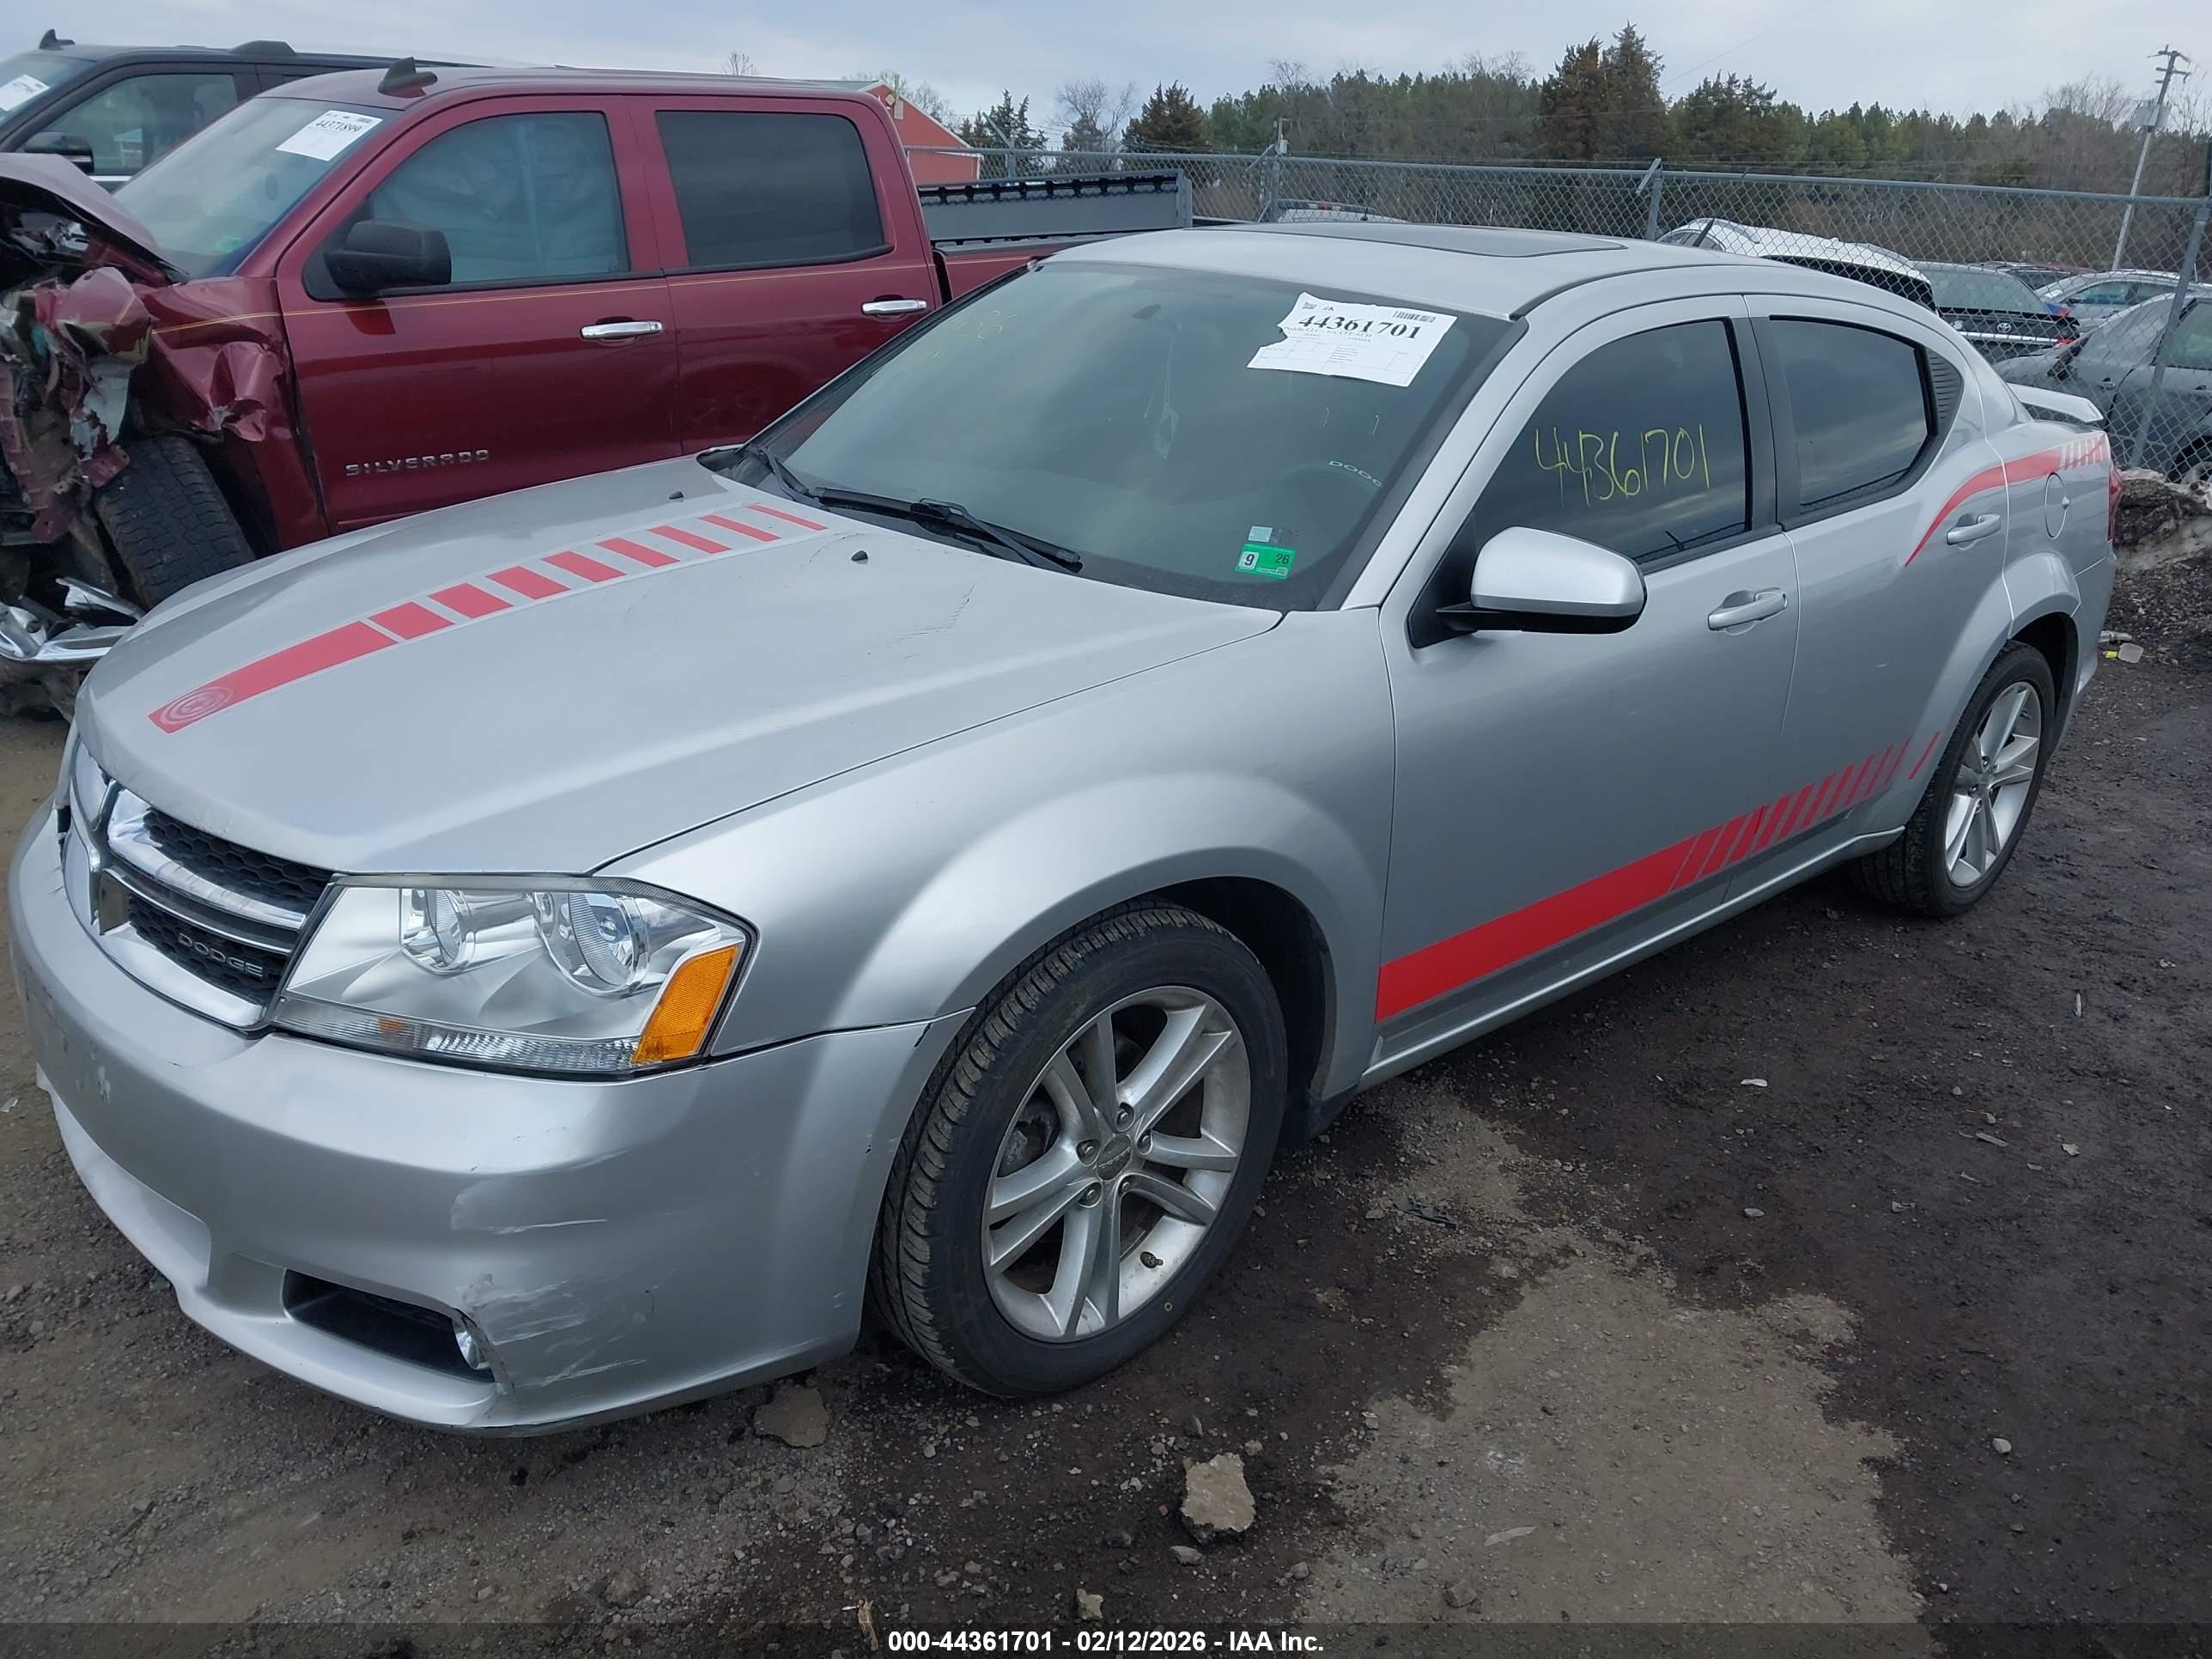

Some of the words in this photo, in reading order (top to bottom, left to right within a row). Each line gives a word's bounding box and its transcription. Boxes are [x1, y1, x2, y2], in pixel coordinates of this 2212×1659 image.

[1298, 314, 1421, 339] 44361701
[345, 449, 489, 477] SILVERADO
[1328, 460, 1382, 488] DODG
[1535, 423, 1711, 509] 44361701
[1244, 554, 1255, 566] 9
[1274, 553, 1290, 565] 26
[178, 932, 264, 978] DODGE
